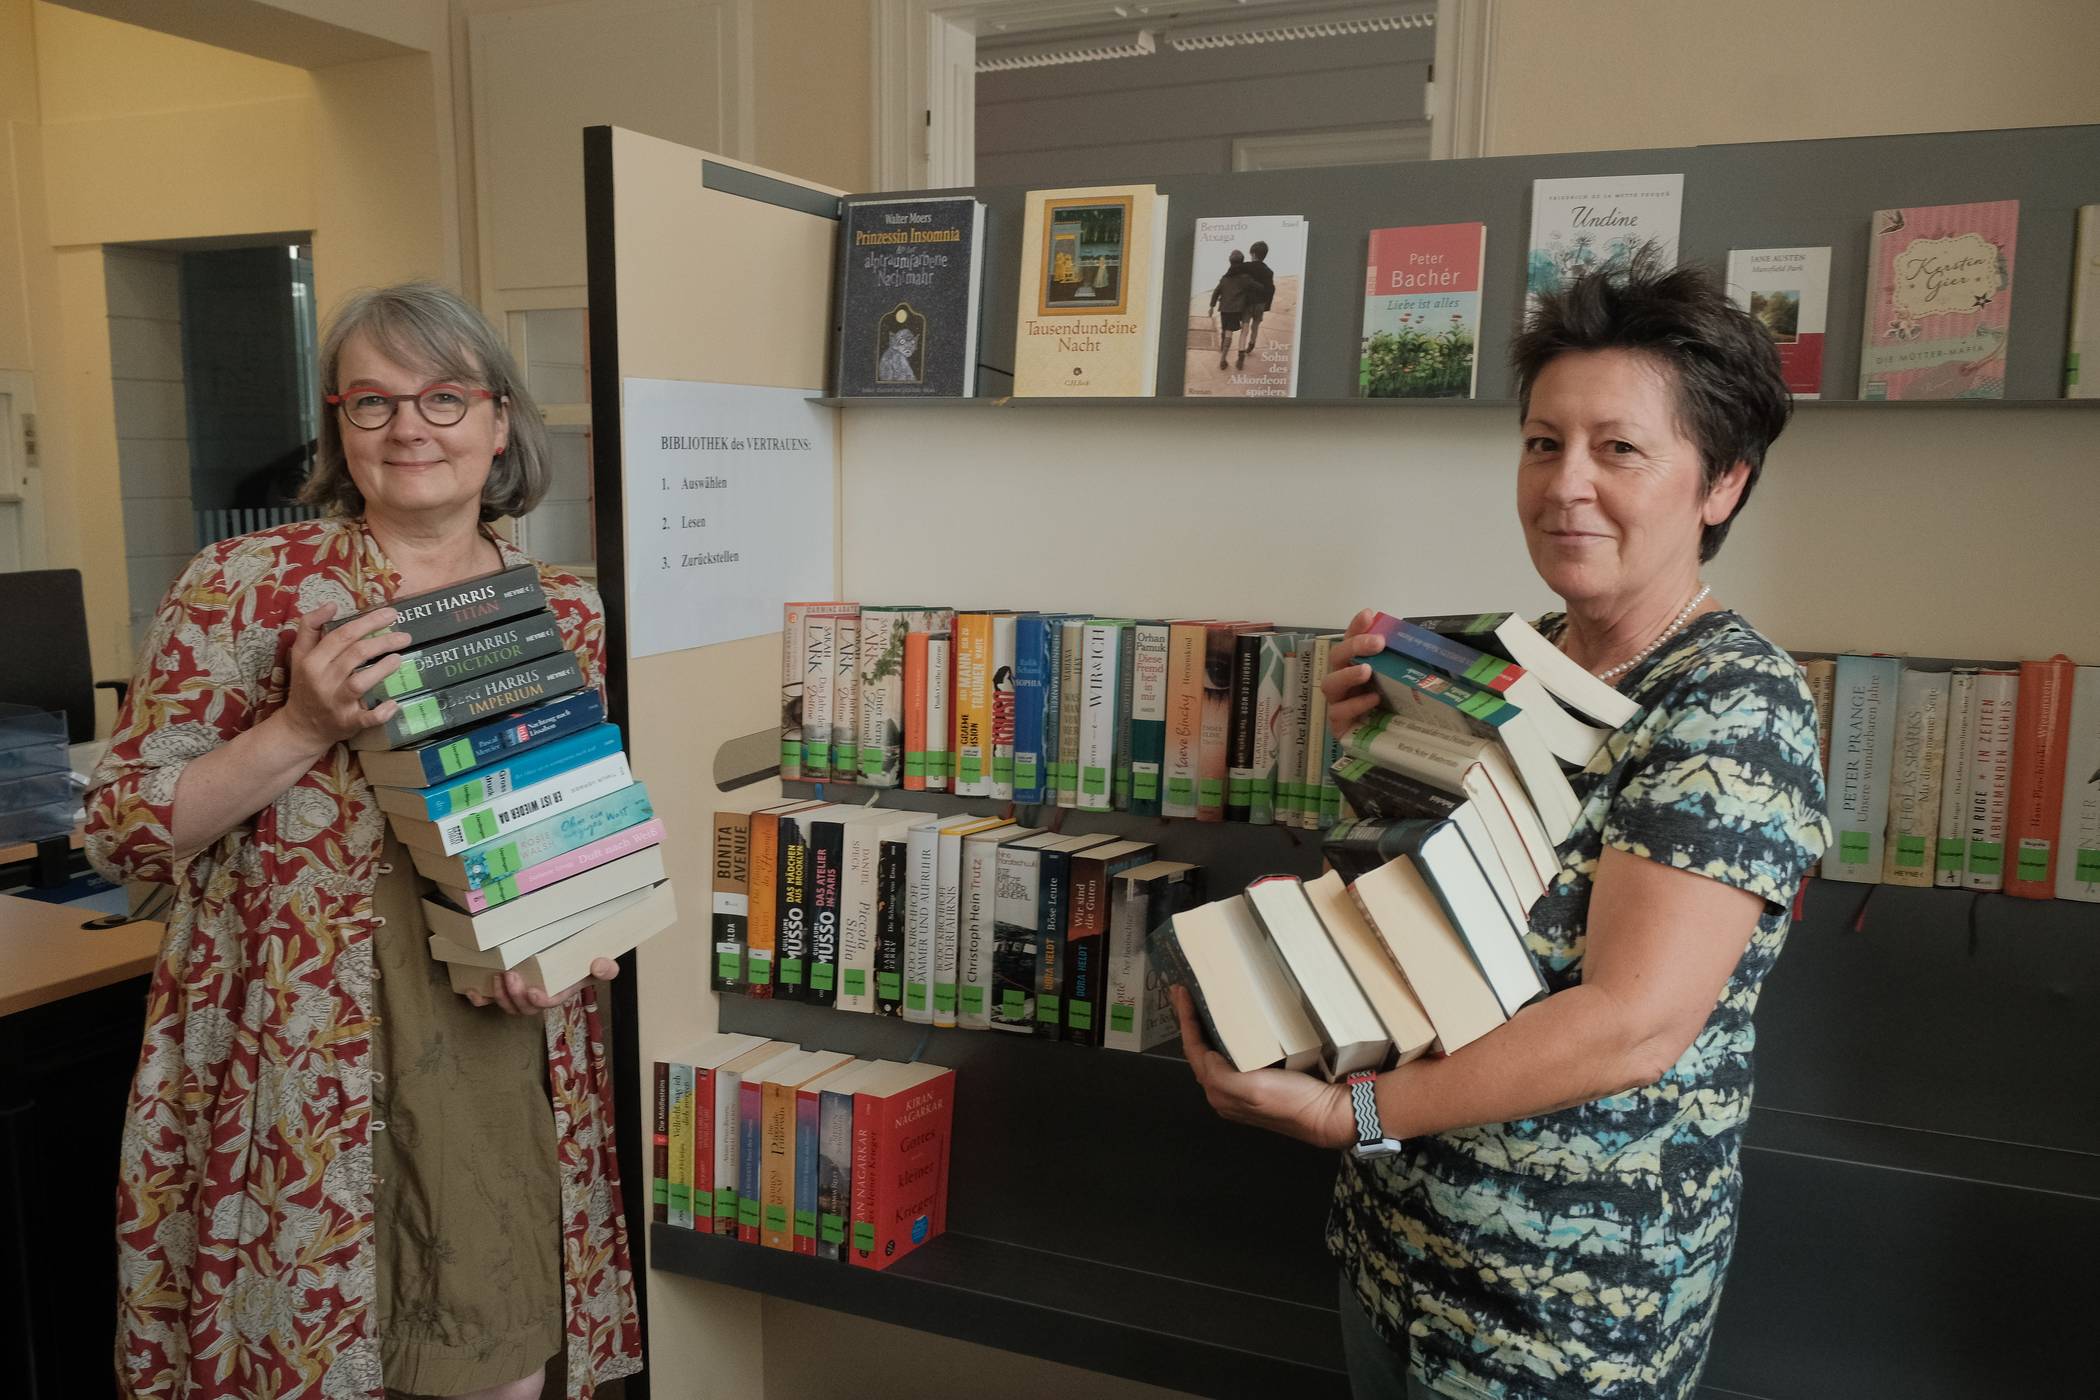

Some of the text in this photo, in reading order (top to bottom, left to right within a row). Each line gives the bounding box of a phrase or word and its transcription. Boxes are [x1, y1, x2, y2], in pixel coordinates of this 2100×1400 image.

[908, 211, 932, 223] Moers
[1200, 221, 1248, 232] Bernardo
[1571, 205, 1640, 228] Undine
[856, 227, 961, 246] Prinzessin Insomnia
[1409, 252, 1445, 267] Peter
[1391, 268, 1462, 289] Bachér
[1924, 270, 1970, 303] Gier
[1386, 297, 1461, 311] Liebe ist alles
[1025, 319, 1137, 337] Tausendundeine
[1058, 336, 1102, 353] Nacht
[1260, 351, 1289, 363] Sohn
[1269, 340, 1290, 352] Der
[1875, 355, 1894, 365] DIE
[1226, 373, 1288, 386] Akkordeon
[1268, 362, 1288, 374] des
[1246, 384, 1287, 398] spielers
[661, 435, 812, 452] BIBLIOTHEK des VERTRAUENS:
[661, 476, 728, 491] 1. Auswählen
[662, 515, 706, 531] 2. Lesen
[661, 550, 740, 570] 3. Zurückstellen
[432, 585, 496, 613] HARRIS
[454, 601, 500, 624] TITAN
[462, 629, 519, 657] HARRIS
[807, 625, 823, 674] LARK
[823, 625, 832, 658] SARAH
[838, 627, 854, 676] LARK
[864, 617, 879, 666] LARK
[1135, 642, 1166, 653] Pamuk
[1136, 632, 1165, 643] Orhan
[445, 644, 523, 679] DICTATOR
[1050, 634, 1061, 673] HENNING
[1063, 649, 1073, 681] MARIANA
[1136, 662, 1164, 673] Fremd
[1138, 653, 1163, 664] Diese
[1183, 636, 1193, 685] Herzenskind
[1299, 651, 1311, 683] Giraffe
[485, 669, 541, 696] HARRIS
[969, 663, 984, 710] TRÄUMEN
[1014, 679, 1042, 688] SOPHIA
[1141, 672, 1158, 683] heit
[1144, 682, 1153, 692] in
[468, 682, 545, 717] IMPERIUM
[876, 688, 886, 718] Unter
[1049, 675, 1060, 713] MANKELL
[1141, 692, 1156, 702] mir
[1298, 685, 1308, 702] der
[1925, 687, 1938, 713] Seite
[960, 713, 969, 745] GRAEME
[1175, 693, 1197, 736] Binchy
[1297, 703, 1308, 726] Hals
[1979, 698, 1995, 743] ZEITEN
[1255, 700, 1266, 766] KLAUS MODICK
[1296, 727, 1306, 745] Der
[1843, 685, 1866, 811] PETER PRANGE
[1903, 709, 1922, 768] SPARKS
[1924, 715, 1936, 750] meiner
[1856, 674, 1881, 823] Unsere wunderbaren Jahre
[1978, 749, 1990, 764] IN
[1990, 700, 2012, 840] ABNEHMENDEN LICHTS
[485, 775, 495, 797] druck
[1918, 783, 1929, 803] Mit
[498, 790, 564, 825] ER IST WIEDER DA
[1974, 791, 1988, 821] RUGE
[2031, 803, 2042, 828] Hans
[578, 849, 603, 865] Duft
[604, 838, 632, 855] nach
[716, 826, 733, 880] BONITA
[734, 825, 749, 884] AVENUE
[860, 848, 871, 886] DANIEL
[786, 844, 797, 903] DAS MÄDCHEN
[794, 845, 805, 904] AUS BROOKLYN
[815, 848, 828, 907] DAS ATELIER
[825, 868, 837, 909] IN PARIS
[919, 849, 932, 934] UND AUFRUHR
[1074, 882, 1086, 928] Wir sind
[1085, 880, 1097, 931] die Guten
[787, 907, 804, 960] MUSSO
[857, 901, 873, 951] Piccola
[943, 885, 957, 972] WIDERFAHRNIS
[966, 858, 983, 984] Christoph Hein Trutz
[1045, 877, 1058, 965] HELDT Böse Leute
[818, 911, 836, 965] MUSSO
[844, 918, 857, 961] Sicilia
[1076, 944, 1088, 998] DORA HELDT
[658, 1079, 666, 1121] Middlesteins
[895, 1098, 945, 1129] NAGARKAR
[905, 1091, 934, 1112] KIRAN
[672, 1106, 681, 1138] Vielleicht
[899, 1128, 938, 1153] Gottes
[856, 1129, 868, 1197] NAGARKAR
[897, 1160, 936, 1189] kleiner
[895, 1192, 938, 1224] Krieger
